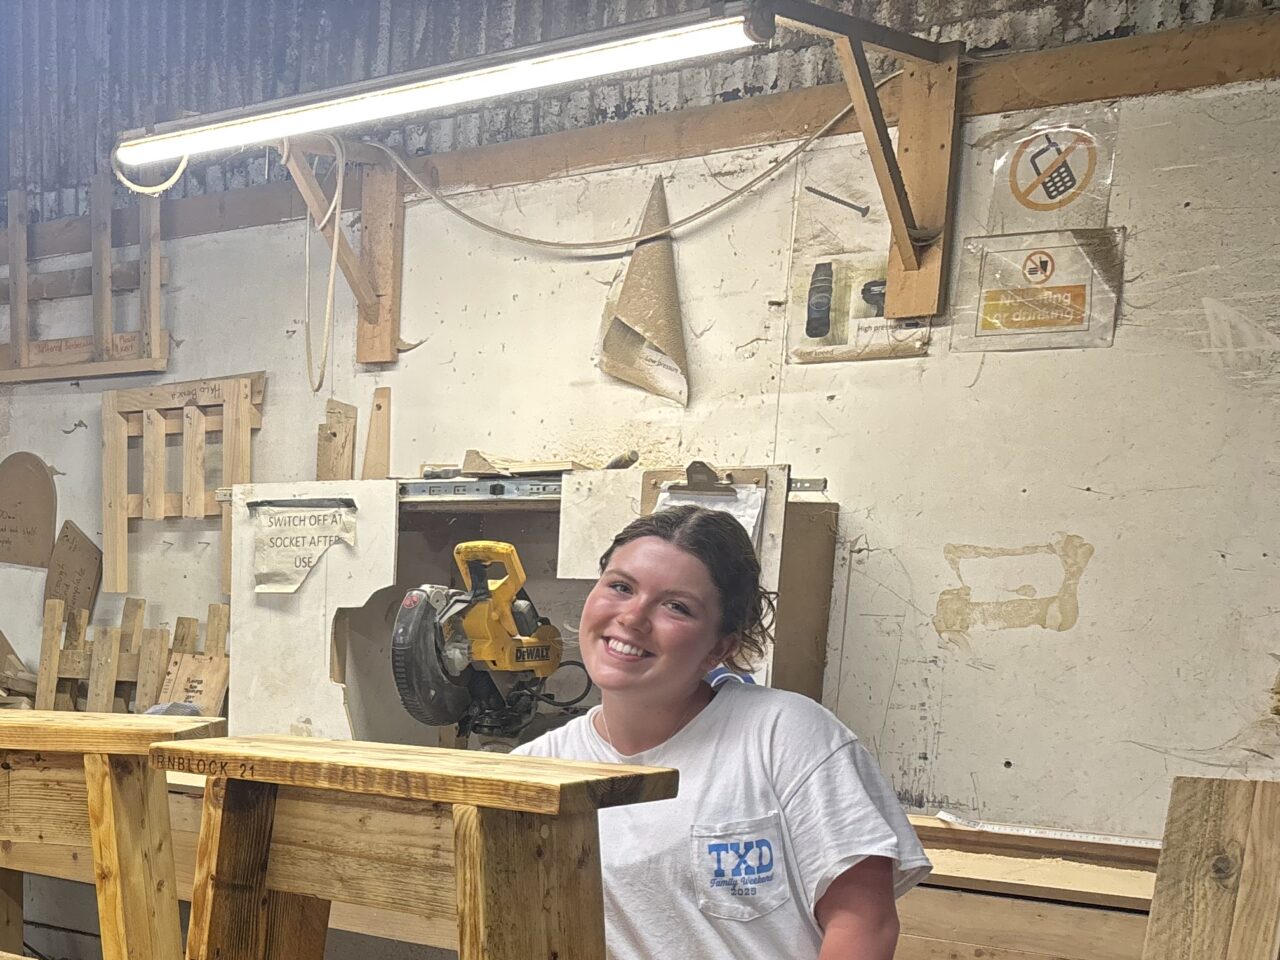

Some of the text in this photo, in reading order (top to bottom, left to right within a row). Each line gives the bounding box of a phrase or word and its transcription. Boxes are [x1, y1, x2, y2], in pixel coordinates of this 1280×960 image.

[857, 324, 873, 334] High
[268, 513, 343, 528] SWITCH OFF AT
[269, 536, 308, 549] SOCKET
[294, 556, 313, 569] USE
[239, 763, 256, 779] 21
[707, 838, 774, 878] TXD
[709, 875, 774, 889] Family Weekend
